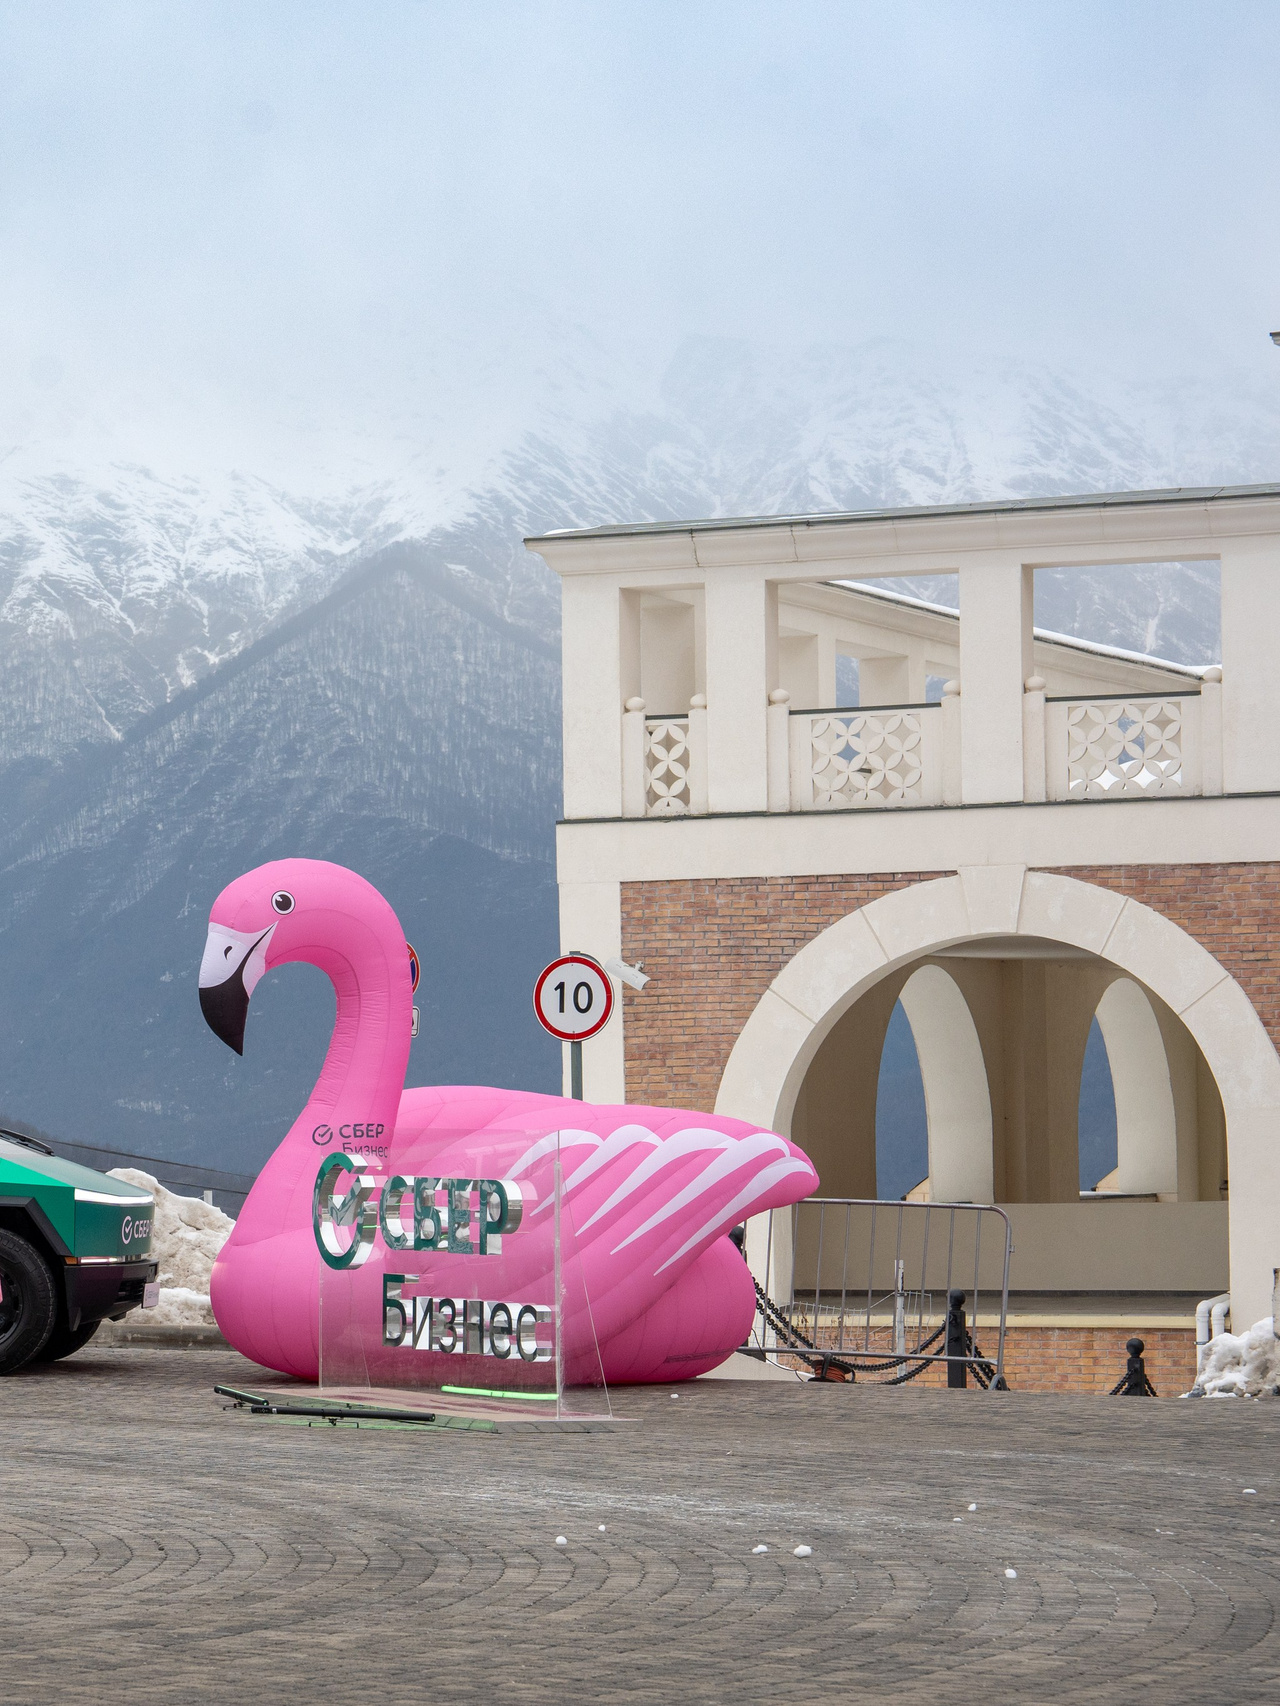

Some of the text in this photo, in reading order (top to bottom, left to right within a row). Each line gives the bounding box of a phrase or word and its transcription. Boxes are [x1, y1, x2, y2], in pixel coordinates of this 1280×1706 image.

[553, 981, 594, 1014] 10
[339, 1123, 385, 1139] СБЕР
[342, 1142, 389, 1158] Бизнес
[379, 1174, 523, 1255] СБЕР
[382, 1273, 550, 1363] Бизнес
